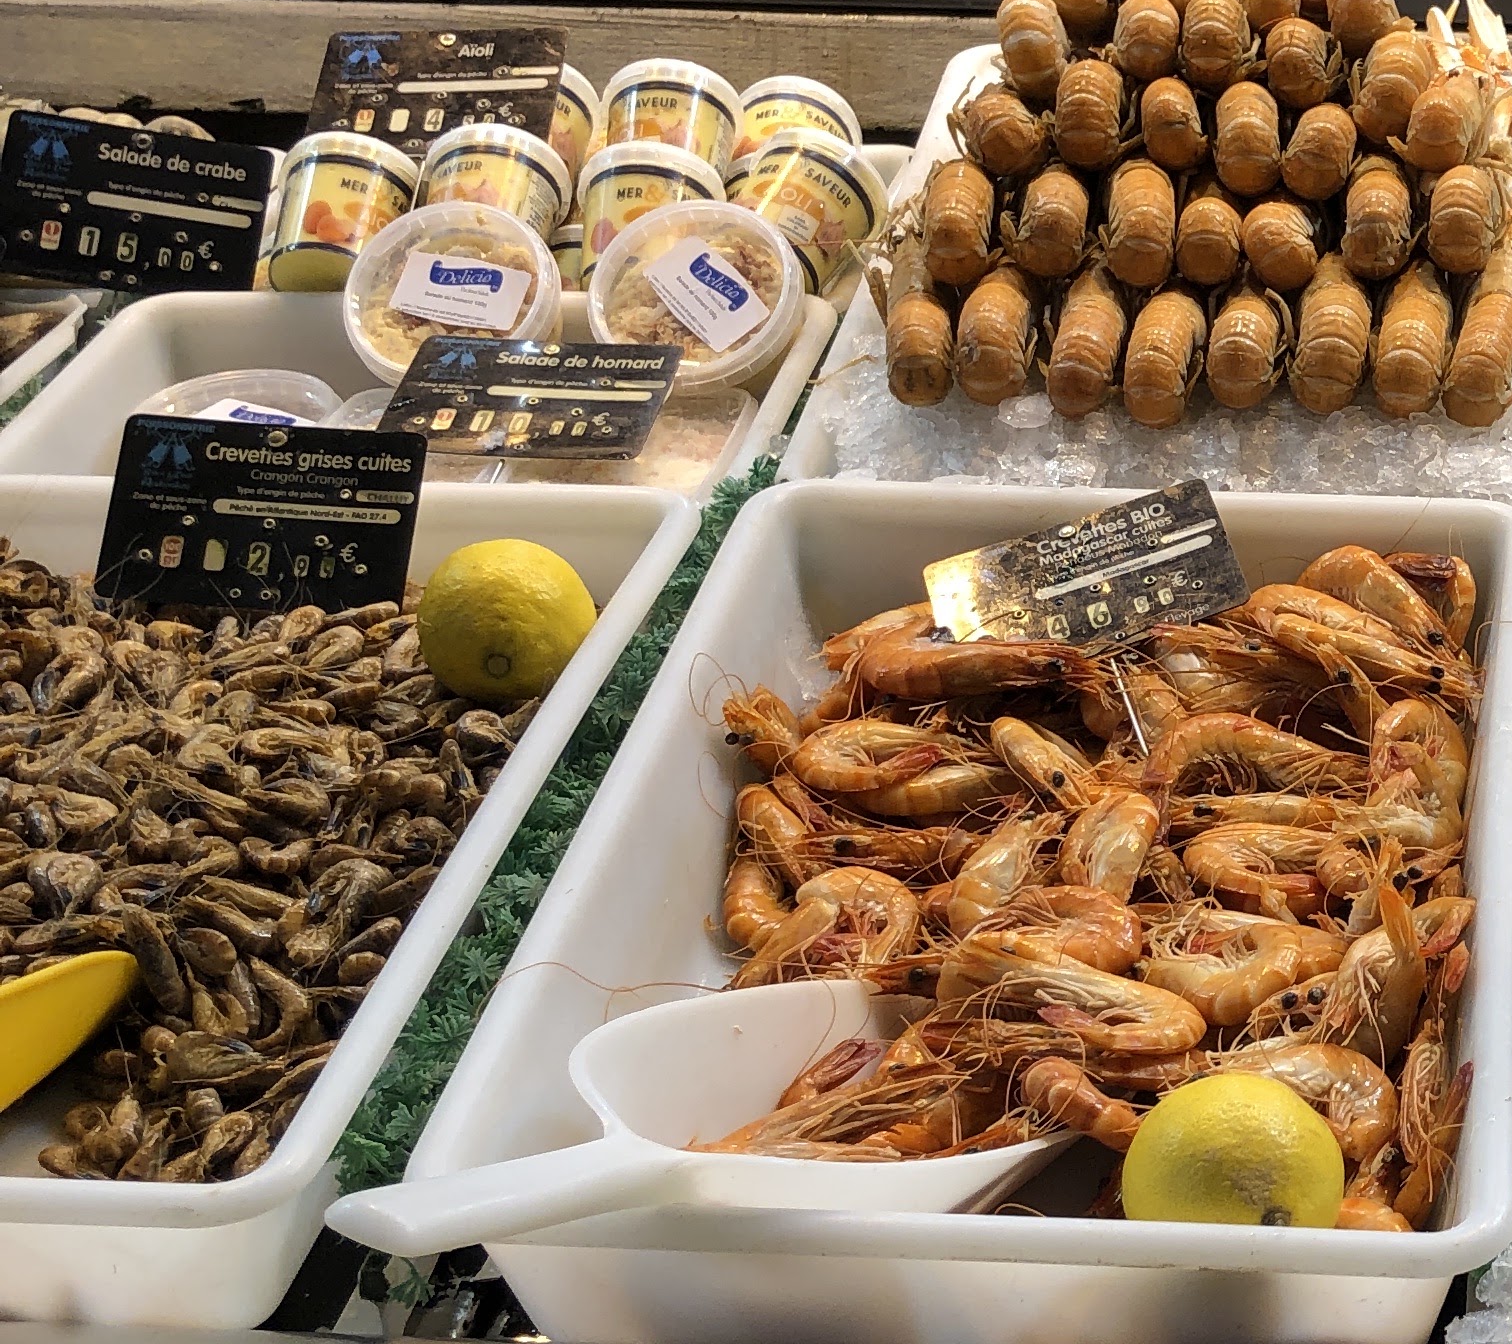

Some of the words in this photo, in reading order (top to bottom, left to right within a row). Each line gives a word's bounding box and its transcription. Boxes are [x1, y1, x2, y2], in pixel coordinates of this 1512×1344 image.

[458, 43, 495, 58] Aïoli
[756, 109, 779, 121] MER
[98, 143, 162, 168] Salade
[167, 154, 190, 173] de
[195, 161, 246, 182] crabe
[340, 177, 369, 195] MER
[616, 188, 644, 200] MER
[757, 164, 780, 176] MER
[805, 168, 851, 209] SAVEUR
[496, 351, 559, 368] Salade
[564, 354, 588, 369] de
[591, 356, 664, 370] homard
[205, 441, 293, 466] Crevettes
[298, 450, 353, 472] grises
[357, 450, 412, 472] cuites
[250, 468, 304, 485] Crangon
[306, 472, 359, 488] Crangon
[1037, 518, 1127, 554] Crevettes
[1130, 503, 1165, 524] BIO
[1039, 531, 1128, 566] Madagascar
[1132, 515, 1173, 536] cuites
[1102, 559, 1150, 578] Madagascar
